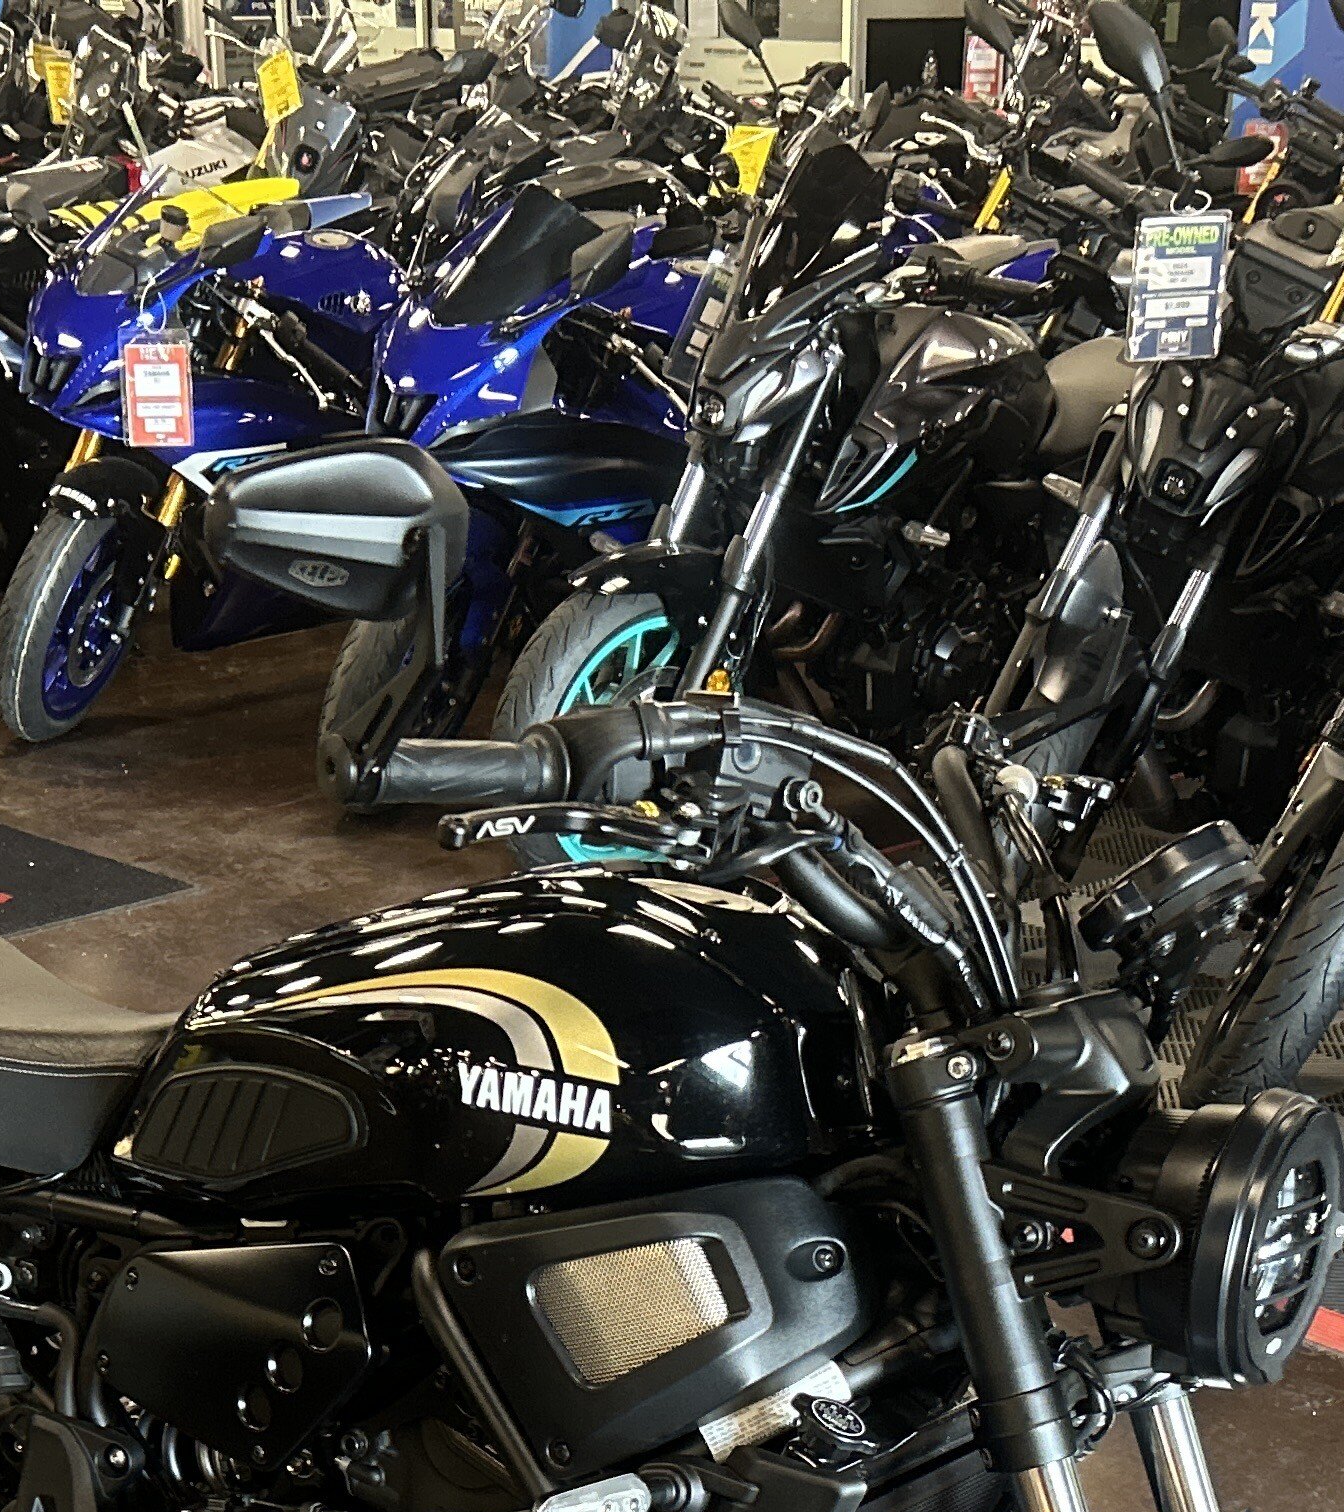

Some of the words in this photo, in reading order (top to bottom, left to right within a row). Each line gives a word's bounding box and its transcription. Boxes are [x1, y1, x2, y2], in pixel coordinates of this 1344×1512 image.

[1146, 225, 1220, 247] PRE-OWNED
[567, 503, 648, 528] R7
[476, 814, 536, 840] ASV
[457, 1062, 611, 1133] YAMAHA
